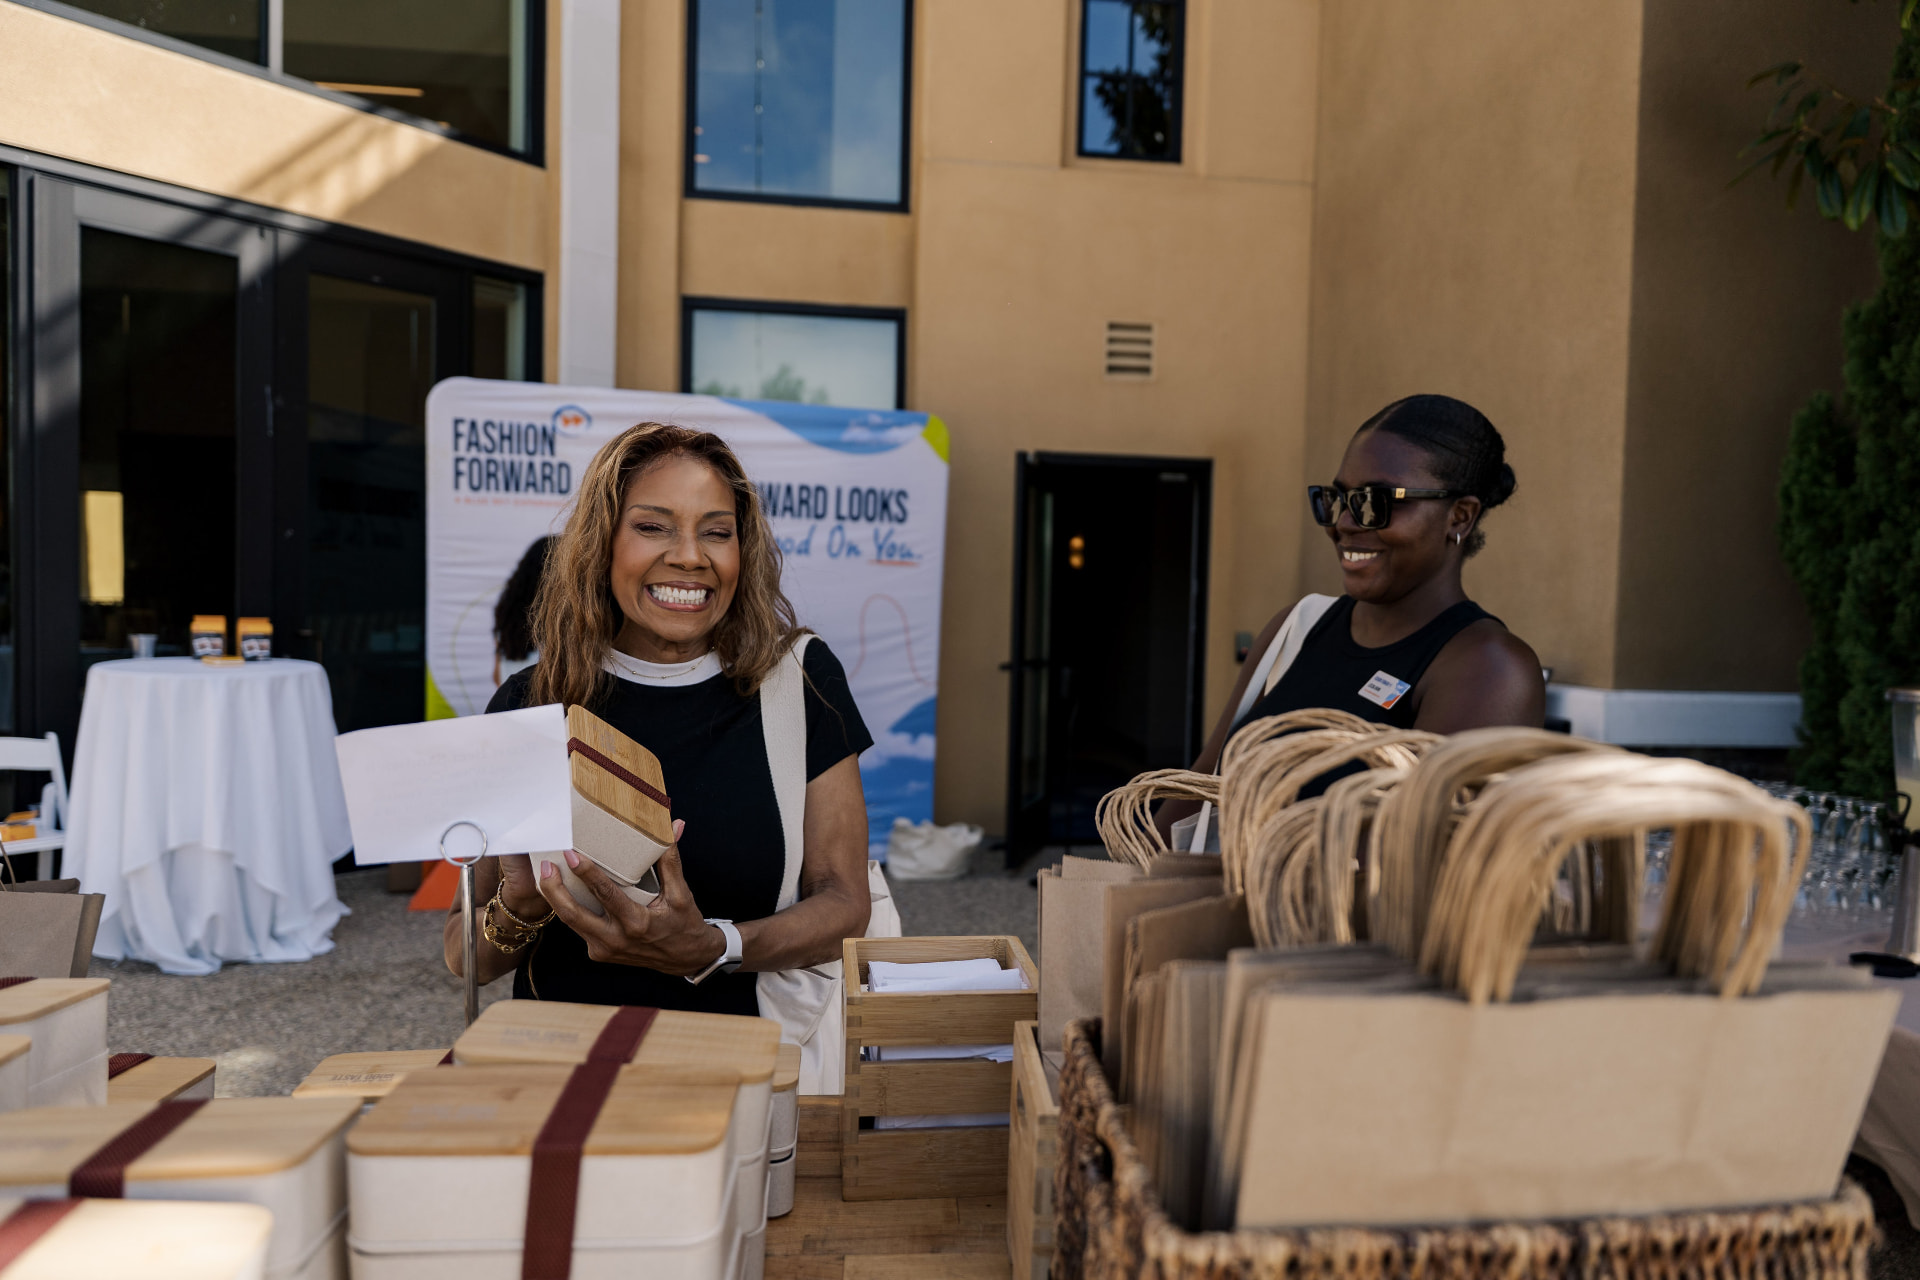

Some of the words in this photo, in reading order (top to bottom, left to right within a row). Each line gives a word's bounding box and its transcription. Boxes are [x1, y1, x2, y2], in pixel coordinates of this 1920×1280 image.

[453, 418, 555, 457] FASHION
[453, 457, 571, 495] FORWARD
[758, 482, 828, 520] WARD
[835, 485, 909, 525] LOOKS
[827, 523, 861, 559] On
